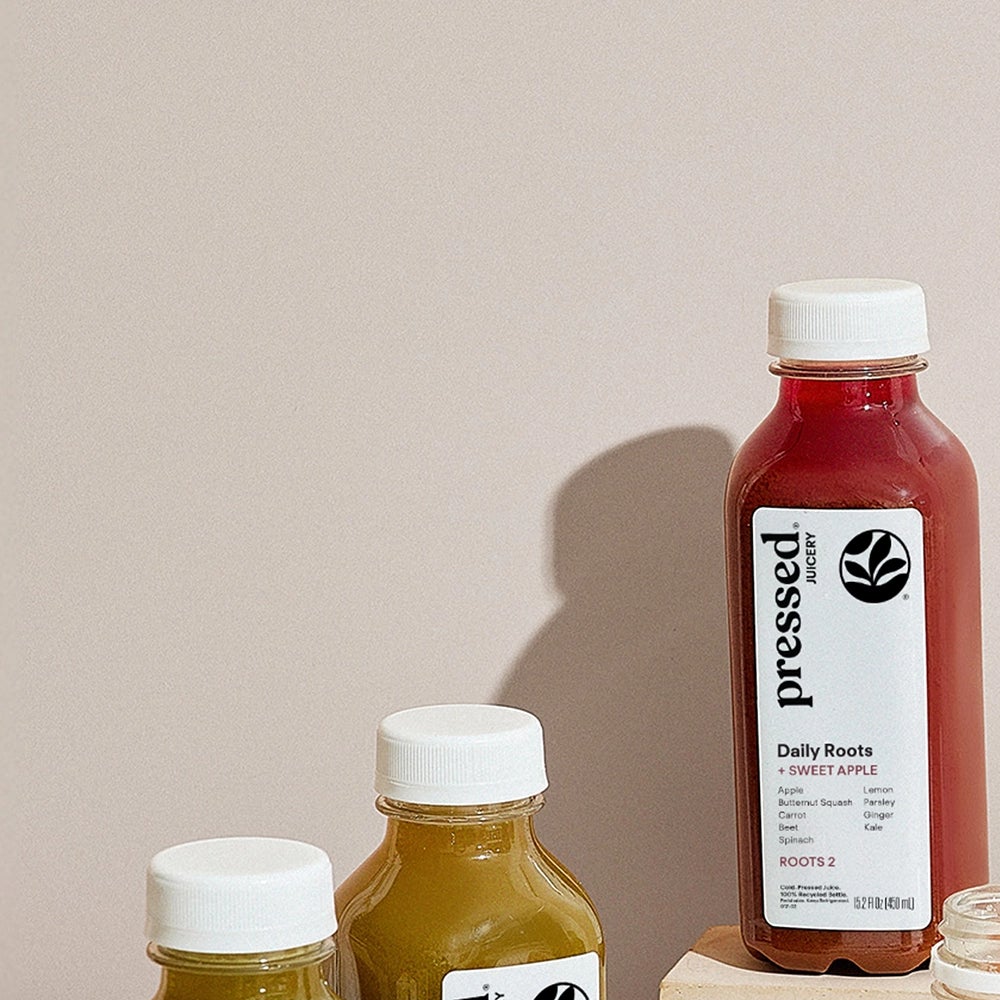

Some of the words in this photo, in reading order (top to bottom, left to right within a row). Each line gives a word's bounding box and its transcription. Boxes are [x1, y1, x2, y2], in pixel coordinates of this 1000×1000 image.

[805, 532, 816, 584] JUICERY
[761, 532, 813, 708] pressed
[778, 744, 820, 760] Daily
[825, 744, 873, 757] Roots
[789, 765, 834, 775] SWEET
[837, 765, 878, 775] APPLE
[778, 787, 803, 795] Apple
[821, 799, 852, 808] Squash
[864, 799, 895, 807] Parsley
[864, 811, 893, 820] Ginger
[779, 836, 814, 845] Spinach
[780, 857, 825, 867] ROOTS
[828, 857, 835, 867] 2
